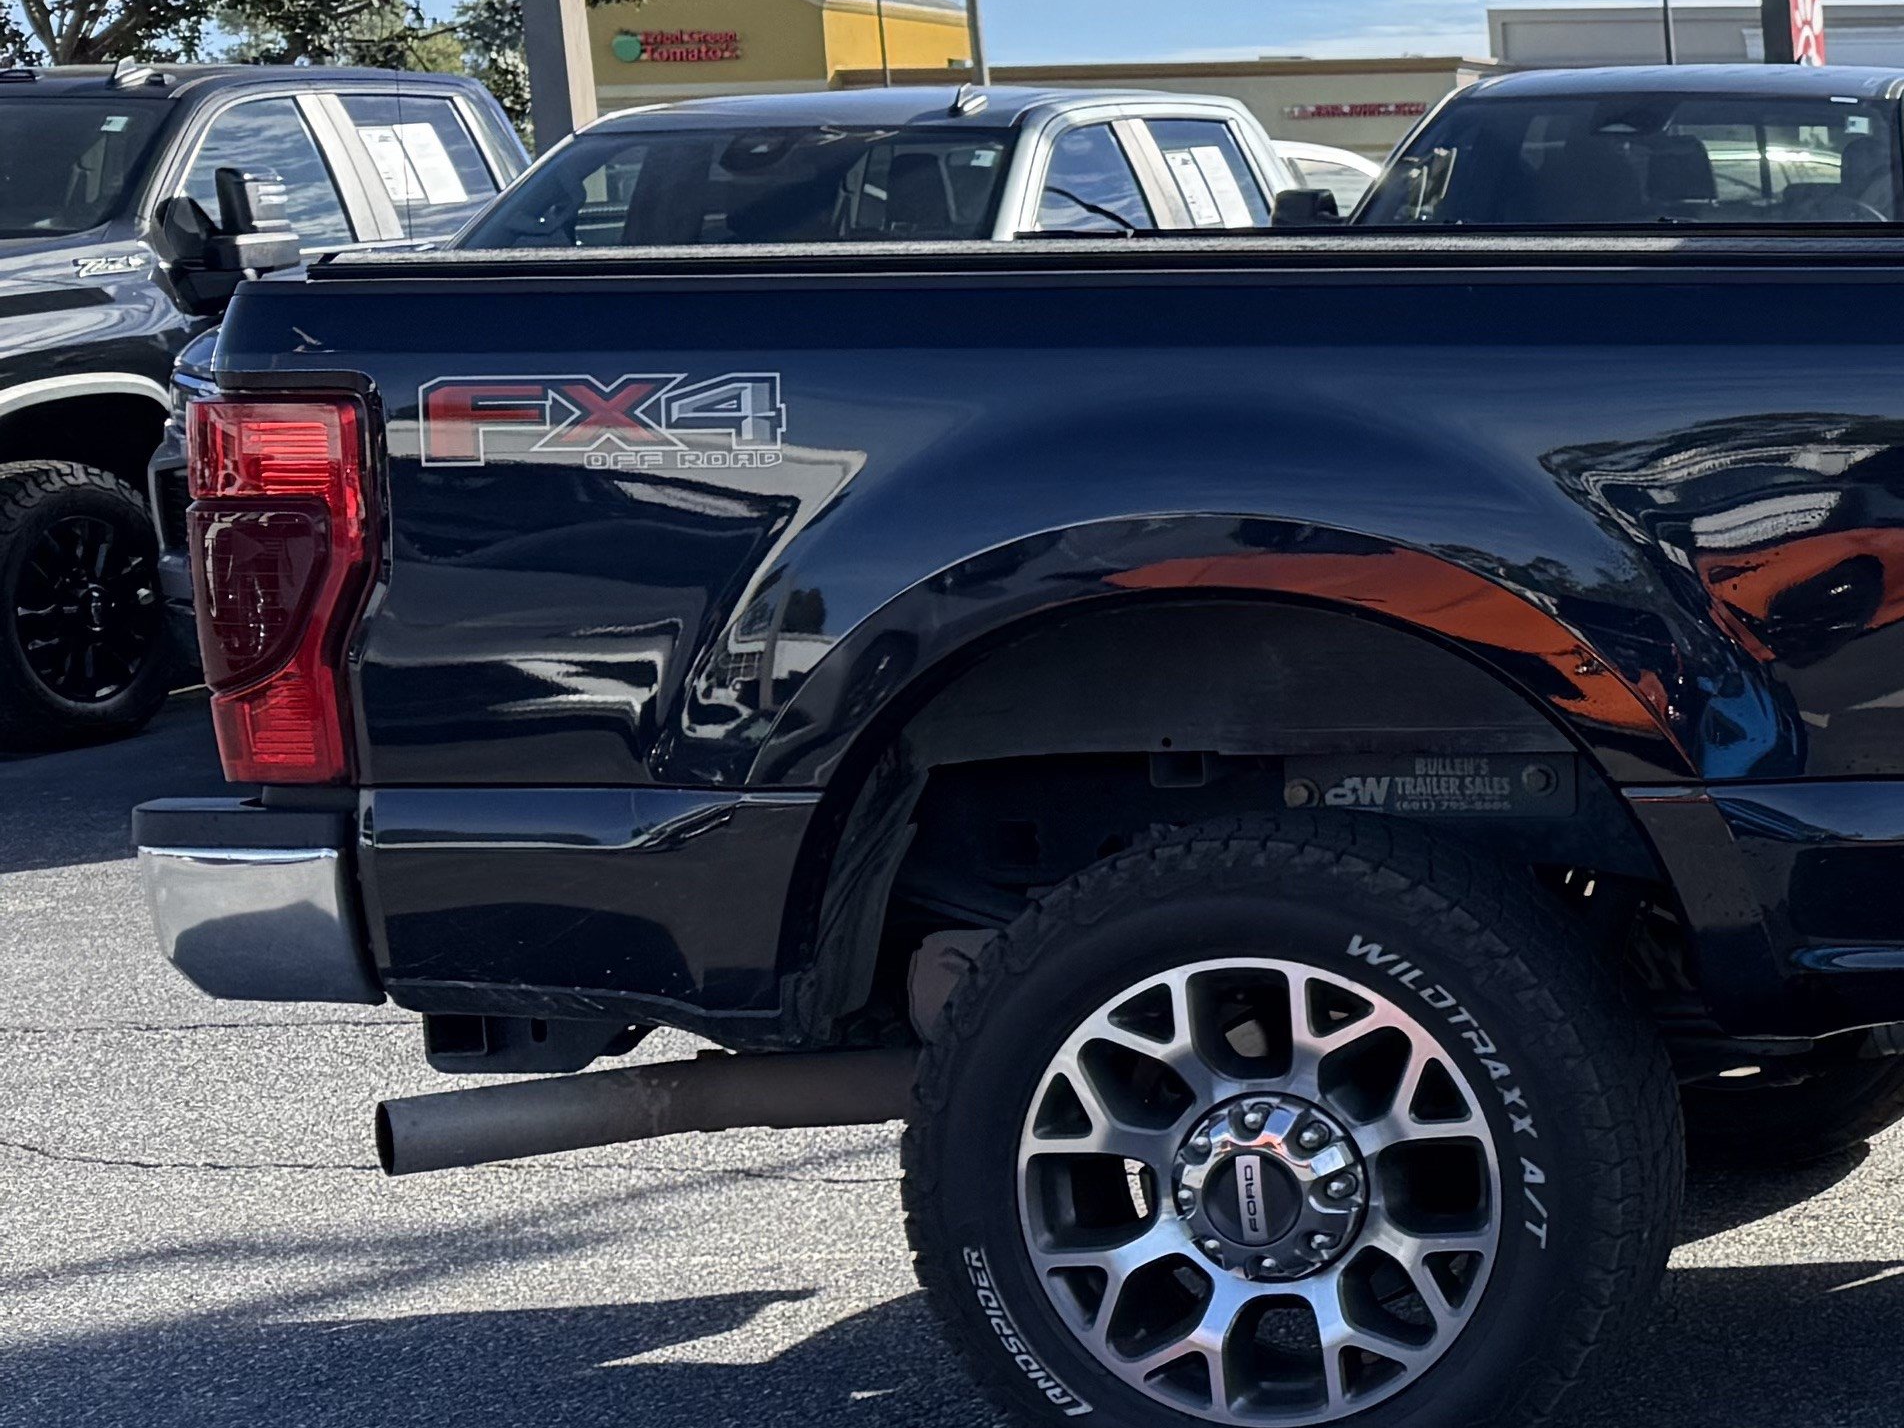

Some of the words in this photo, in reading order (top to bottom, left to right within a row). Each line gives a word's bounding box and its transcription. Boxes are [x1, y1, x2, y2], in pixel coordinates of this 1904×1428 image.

[418, 373, 787, 467] FX4
[584, 450, 664, 469] OFF
[677, 450, 783, 469] ROAD
[1395, 777, 1461, 795] TRAILER
[1464, 777, 1511, 795] SALES
[1346, 935, 1538, 1139] WILDTRAXX
[1520, 1156, 1548, 1249] A/T
[1244, 1165, 1260, 1233] FORD
[963, 1246, 1094, 1417] LANDSPIDER
